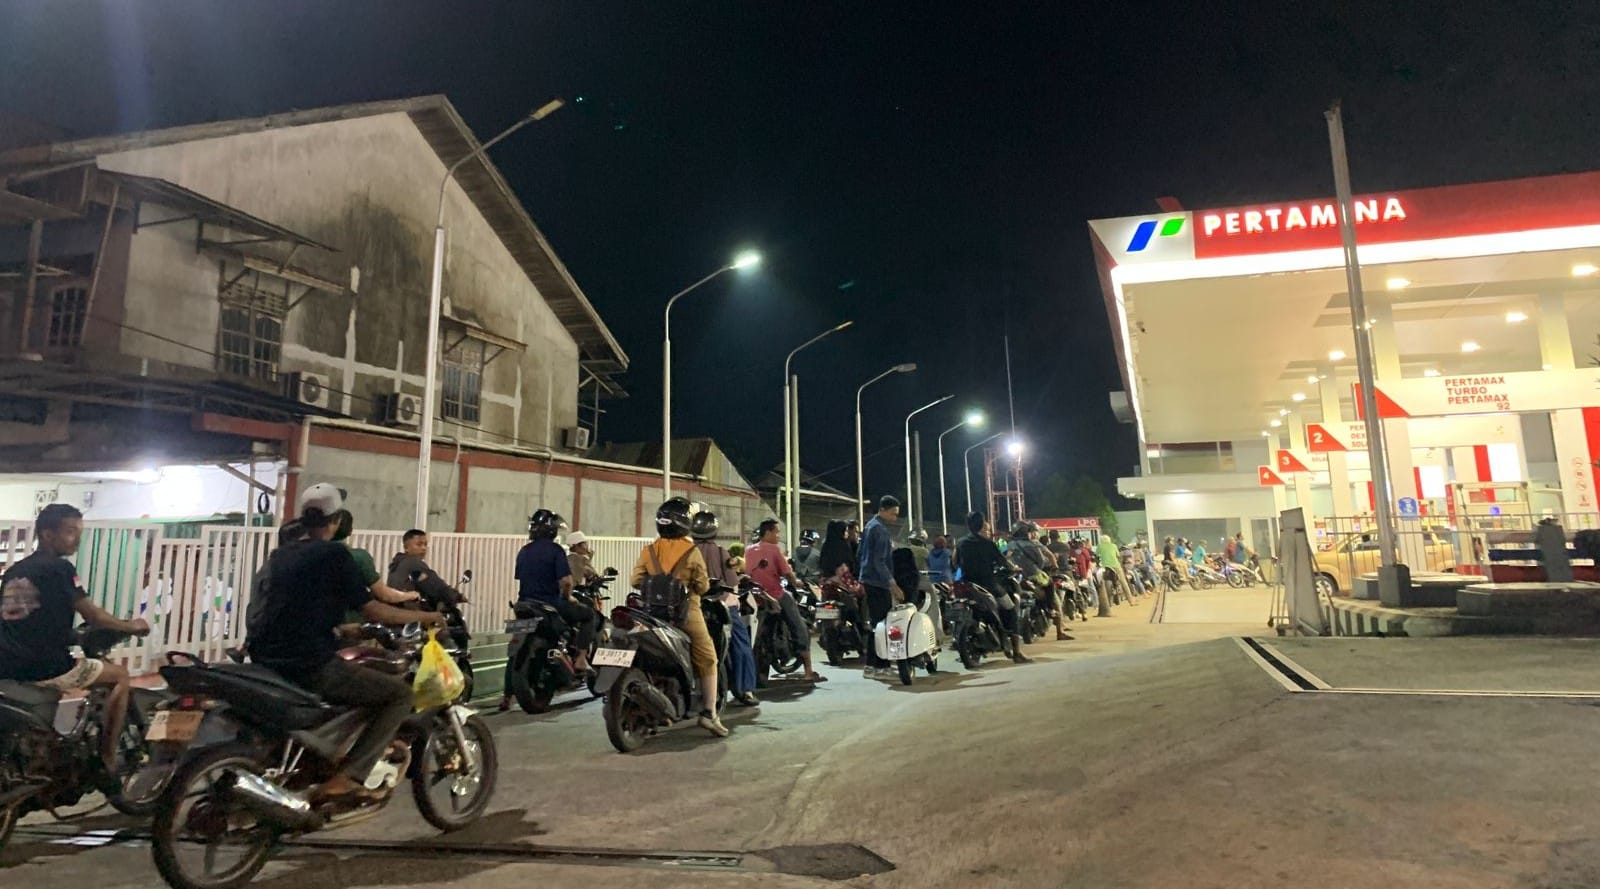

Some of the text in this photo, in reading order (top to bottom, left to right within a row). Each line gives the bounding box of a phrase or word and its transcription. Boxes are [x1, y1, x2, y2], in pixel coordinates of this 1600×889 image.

[1445, 376, 1506, 387] PERTAMAX
[1447, 386, 1488, 396] TURBO
[1448, 394, 1509, 405] PERTAMAX
[1497, 402, 1511, 411] 92
[1313, 431, 1324, 444] 2
[1282, 456, 1291, 466] 3
[1077, 519, 1097, 527] LPG
